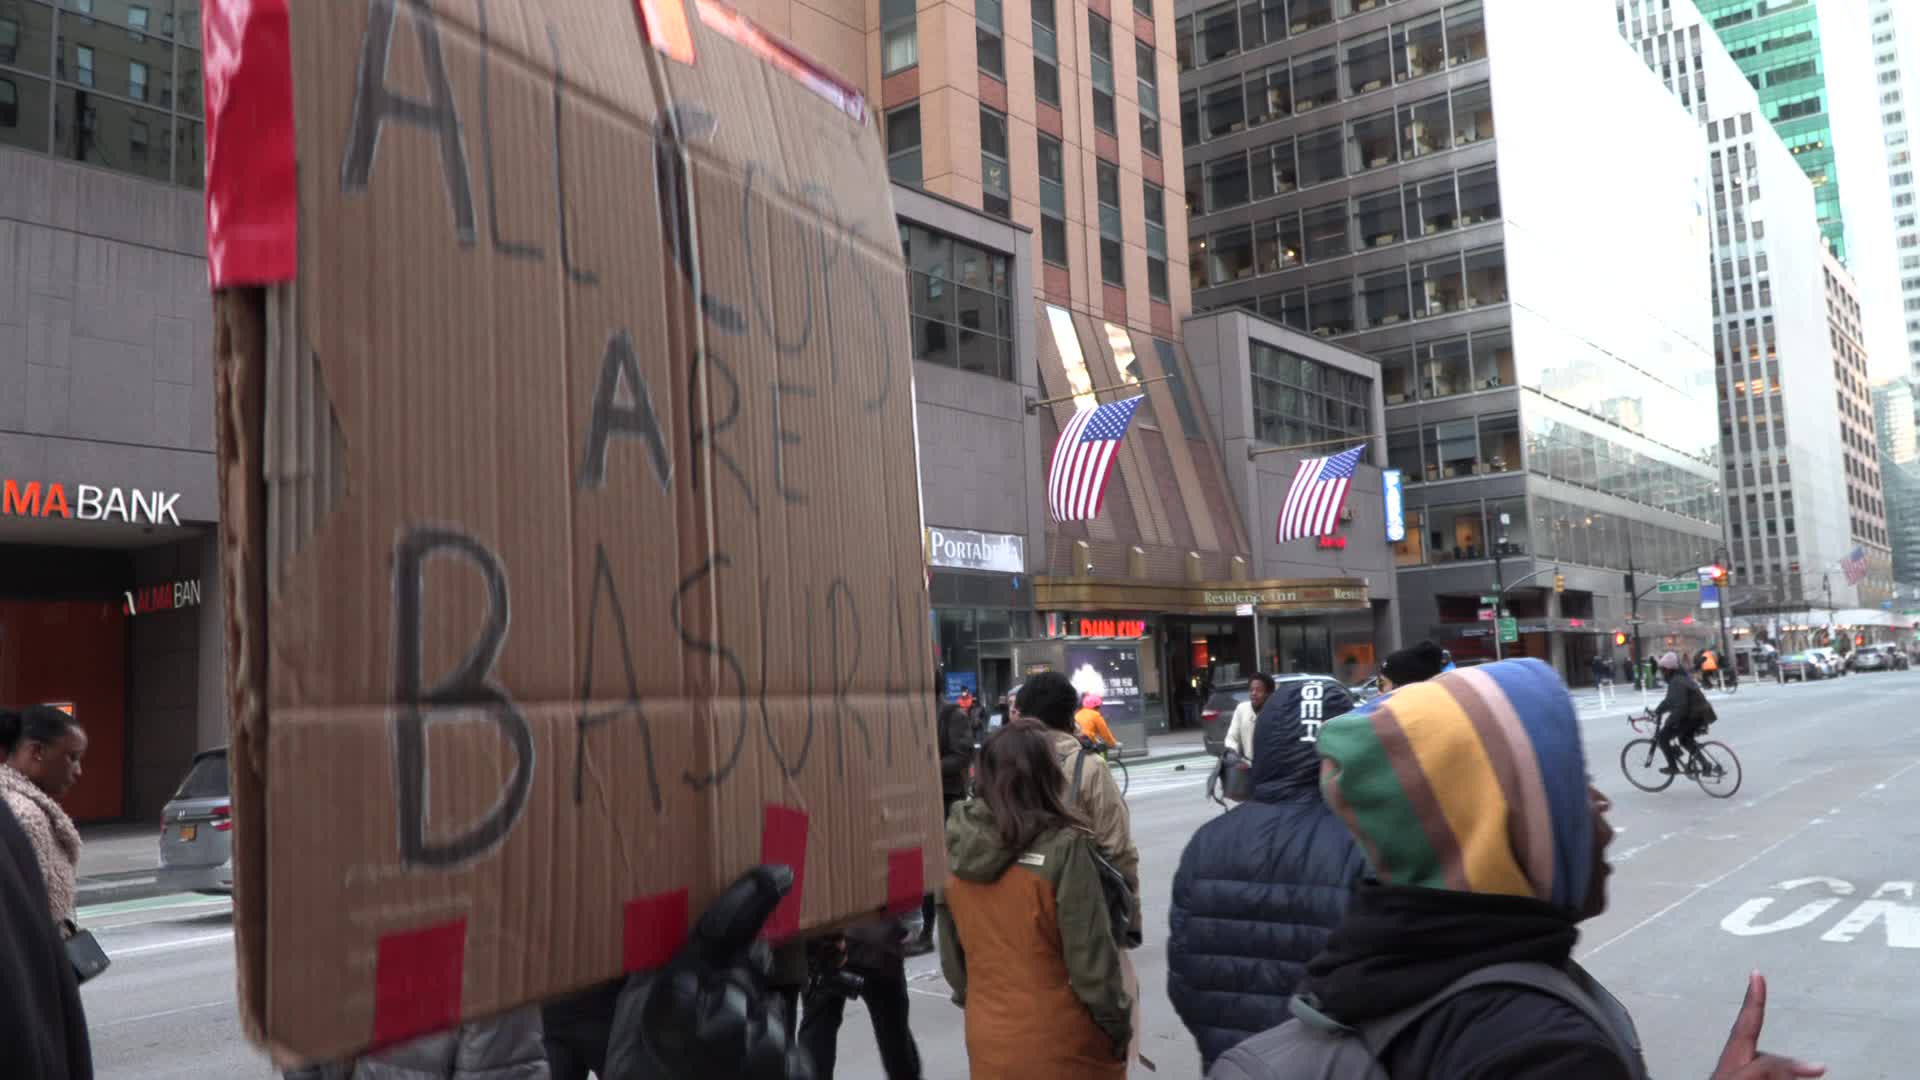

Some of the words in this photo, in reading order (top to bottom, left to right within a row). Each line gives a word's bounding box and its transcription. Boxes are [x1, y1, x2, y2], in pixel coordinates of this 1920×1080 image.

[340, 0, 599, 286] ALL
[653, 104, 891, 412] COPS
[76, 484, 181, 527] BANK
[577, 330, 816, 515] ARE
